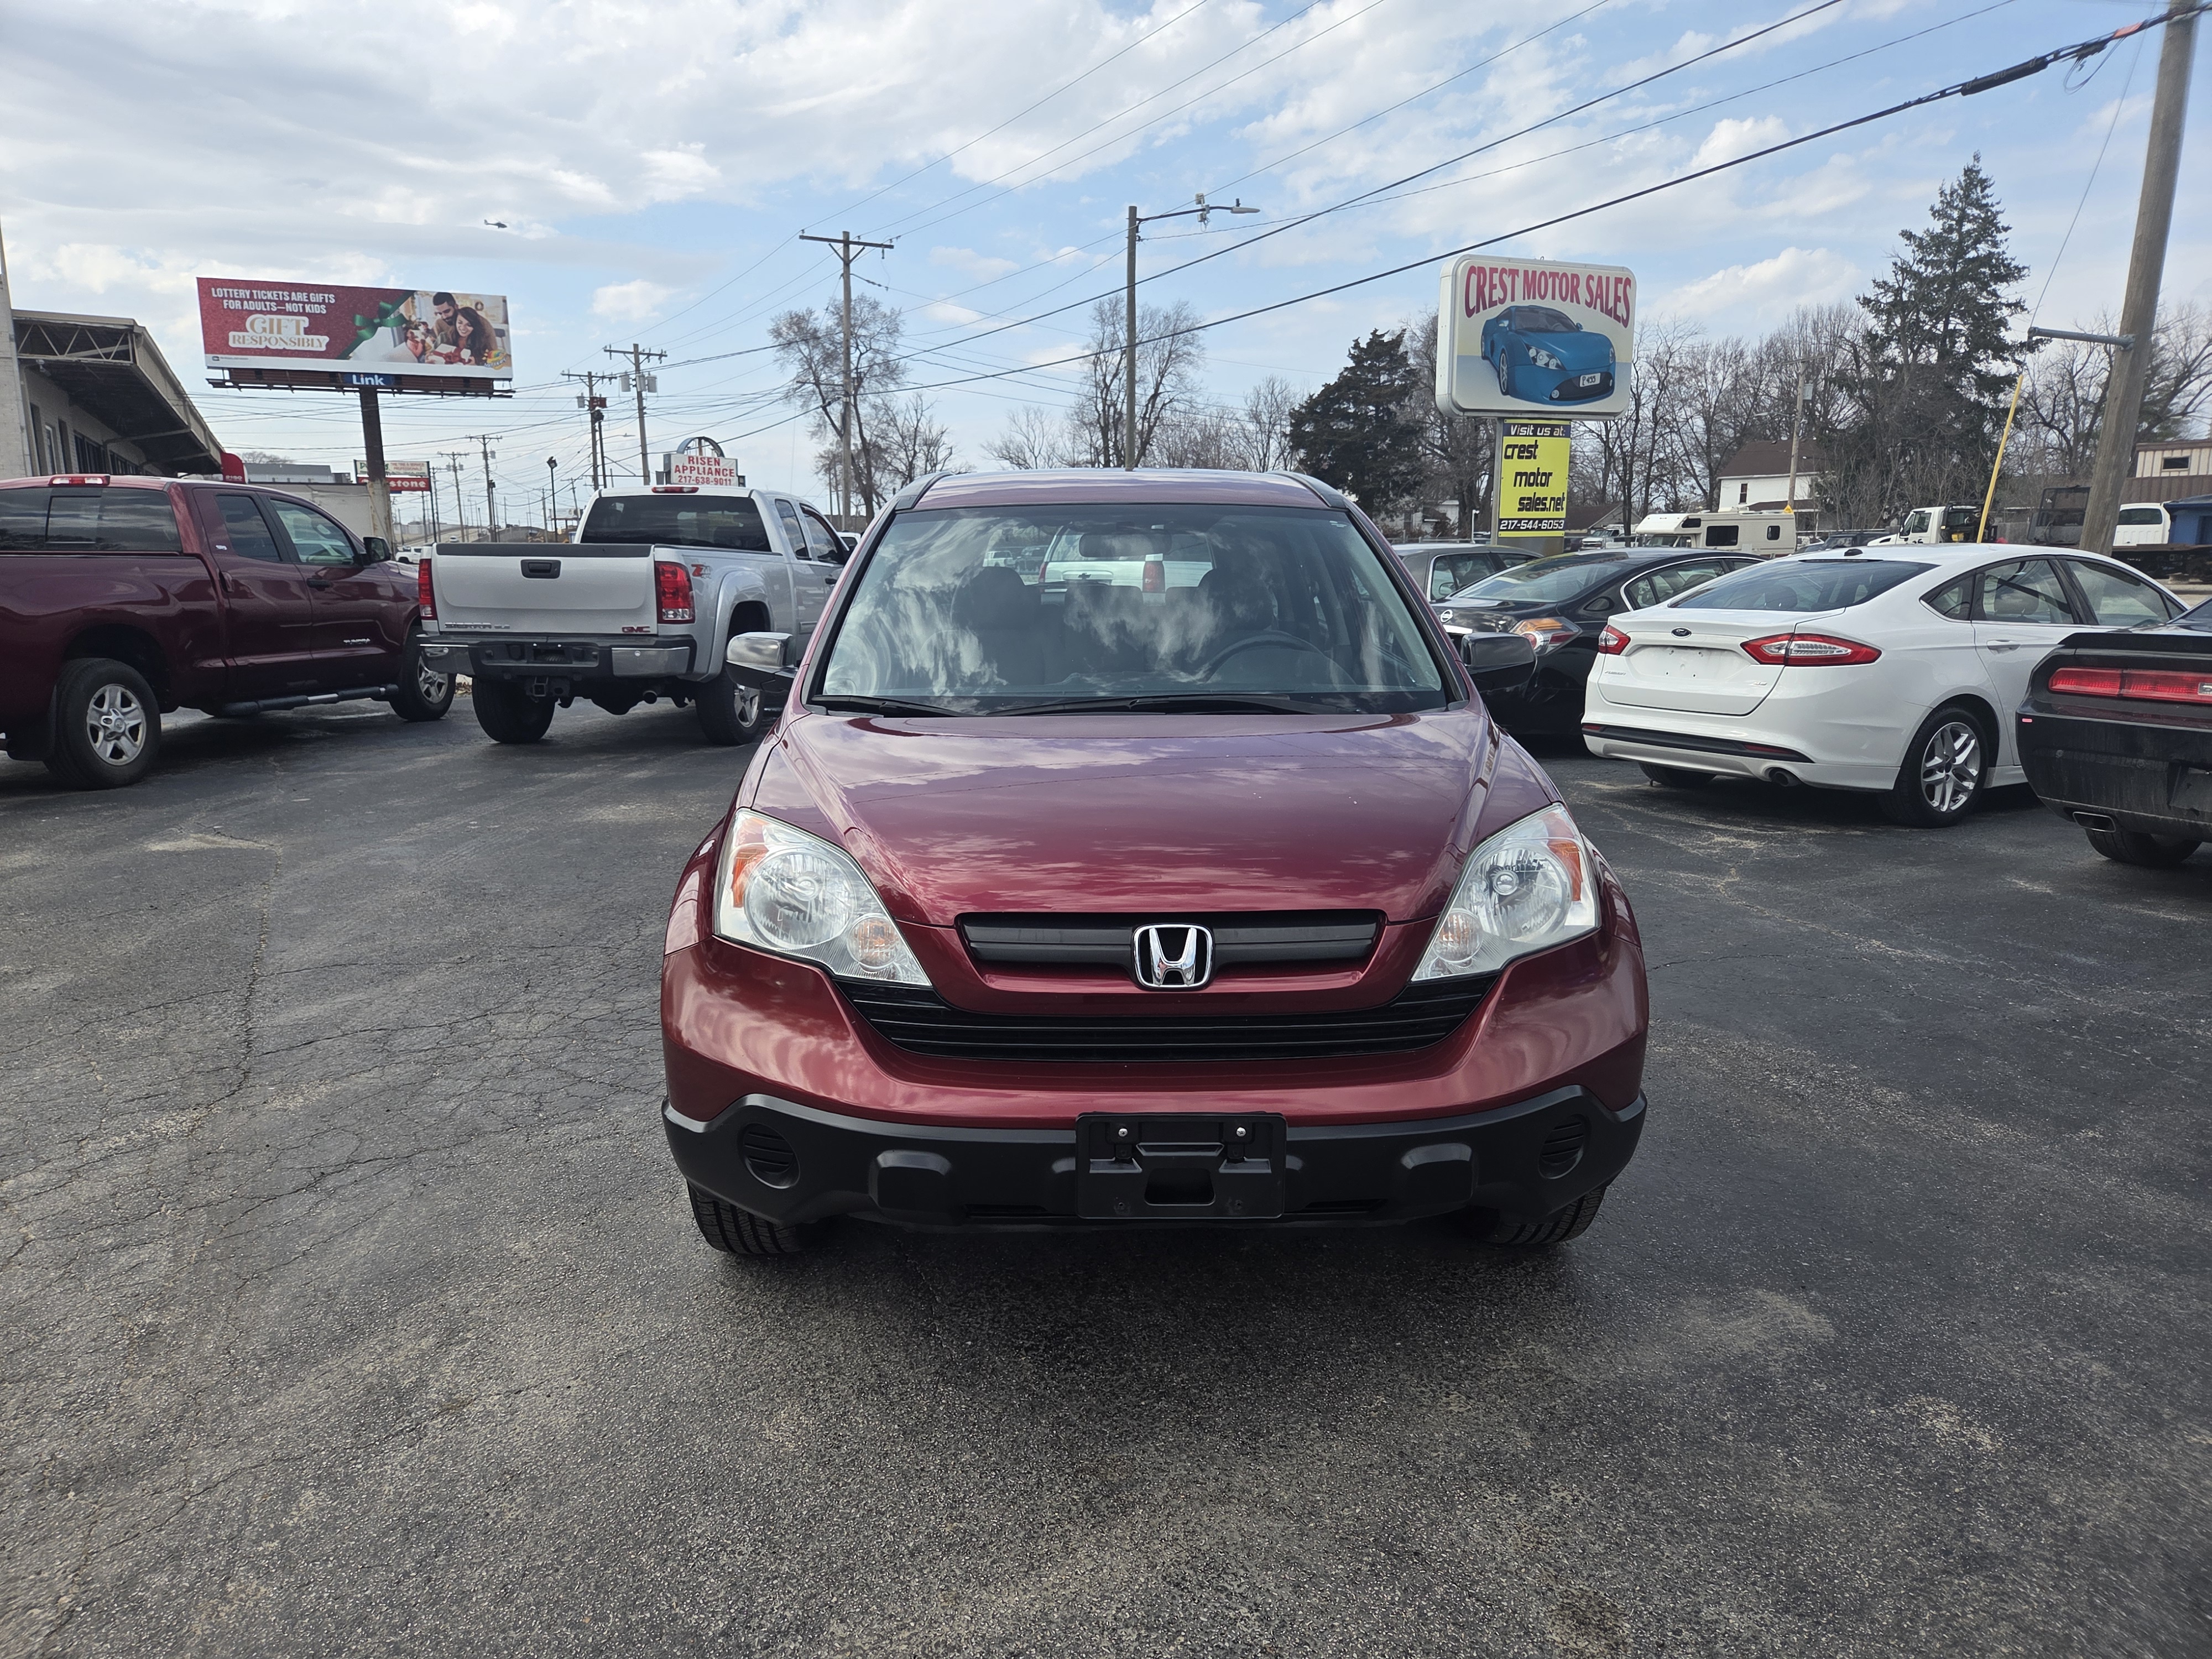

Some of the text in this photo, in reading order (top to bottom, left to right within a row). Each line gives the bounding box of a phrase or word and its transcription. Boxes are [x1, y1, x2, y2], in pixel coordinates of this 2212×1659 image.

[211, 288, 335, 304] LOTTERY TICKETS ARE GIFTS
[1465, 265, 1631, 328] CREST MOTOR SALES
[223, 300, 242, 310] FOR
[305, 304, 326, 314] KIDS
[249, 317, 306, 335] GIFT
[232, 335, 326, 348] RESPONSIBLY
[352, 374, 385, 385] Link
[1511, 425, 1565, 436] Visit us at:
[1504, 440, 1538, 460] crest
[688, 456, 720, 466] RISEN
[675, 465, 735, 477] APPLIANCE
[1514, 467, 1553, 487] motor
[678, 476, 732, 486] 217-638-9011
[1517, 492, 1565, 512] sales.net
[1500, 520, 1564, 529] 217-544-6053
